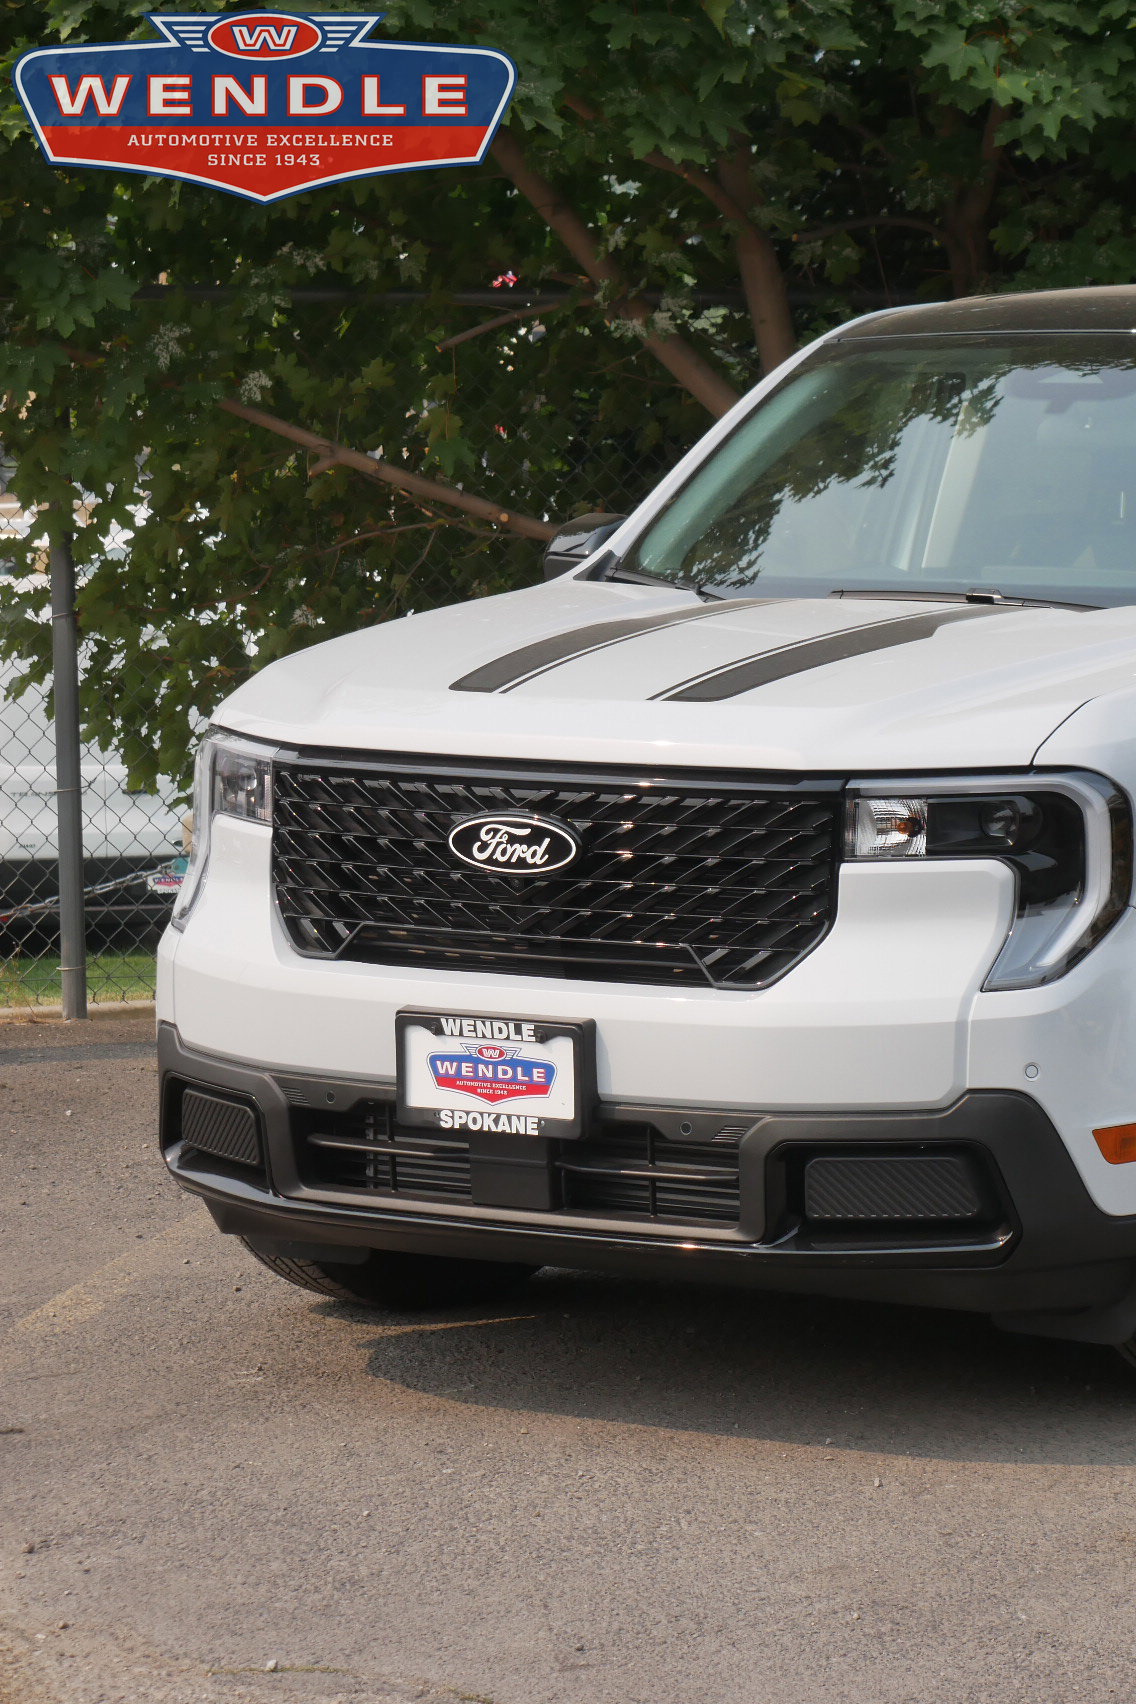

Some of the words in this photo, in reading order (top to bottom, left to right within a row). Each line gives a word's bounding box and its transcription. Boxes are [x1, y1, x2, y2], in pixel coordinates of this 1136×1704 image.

[472, 823, 551, 865] Ford
[440, 1018, 536, 1042] WENDLE
[482, 1048, 501, 1059] W
[436, 1060, 547, 1082] WENDLE
[456, 1080, 491, 1088] AUTOMOTIVE
[492, 1082, 527, 1091] EXCELLENCE
[440, 1109, 539, 1136] SPOKANE
